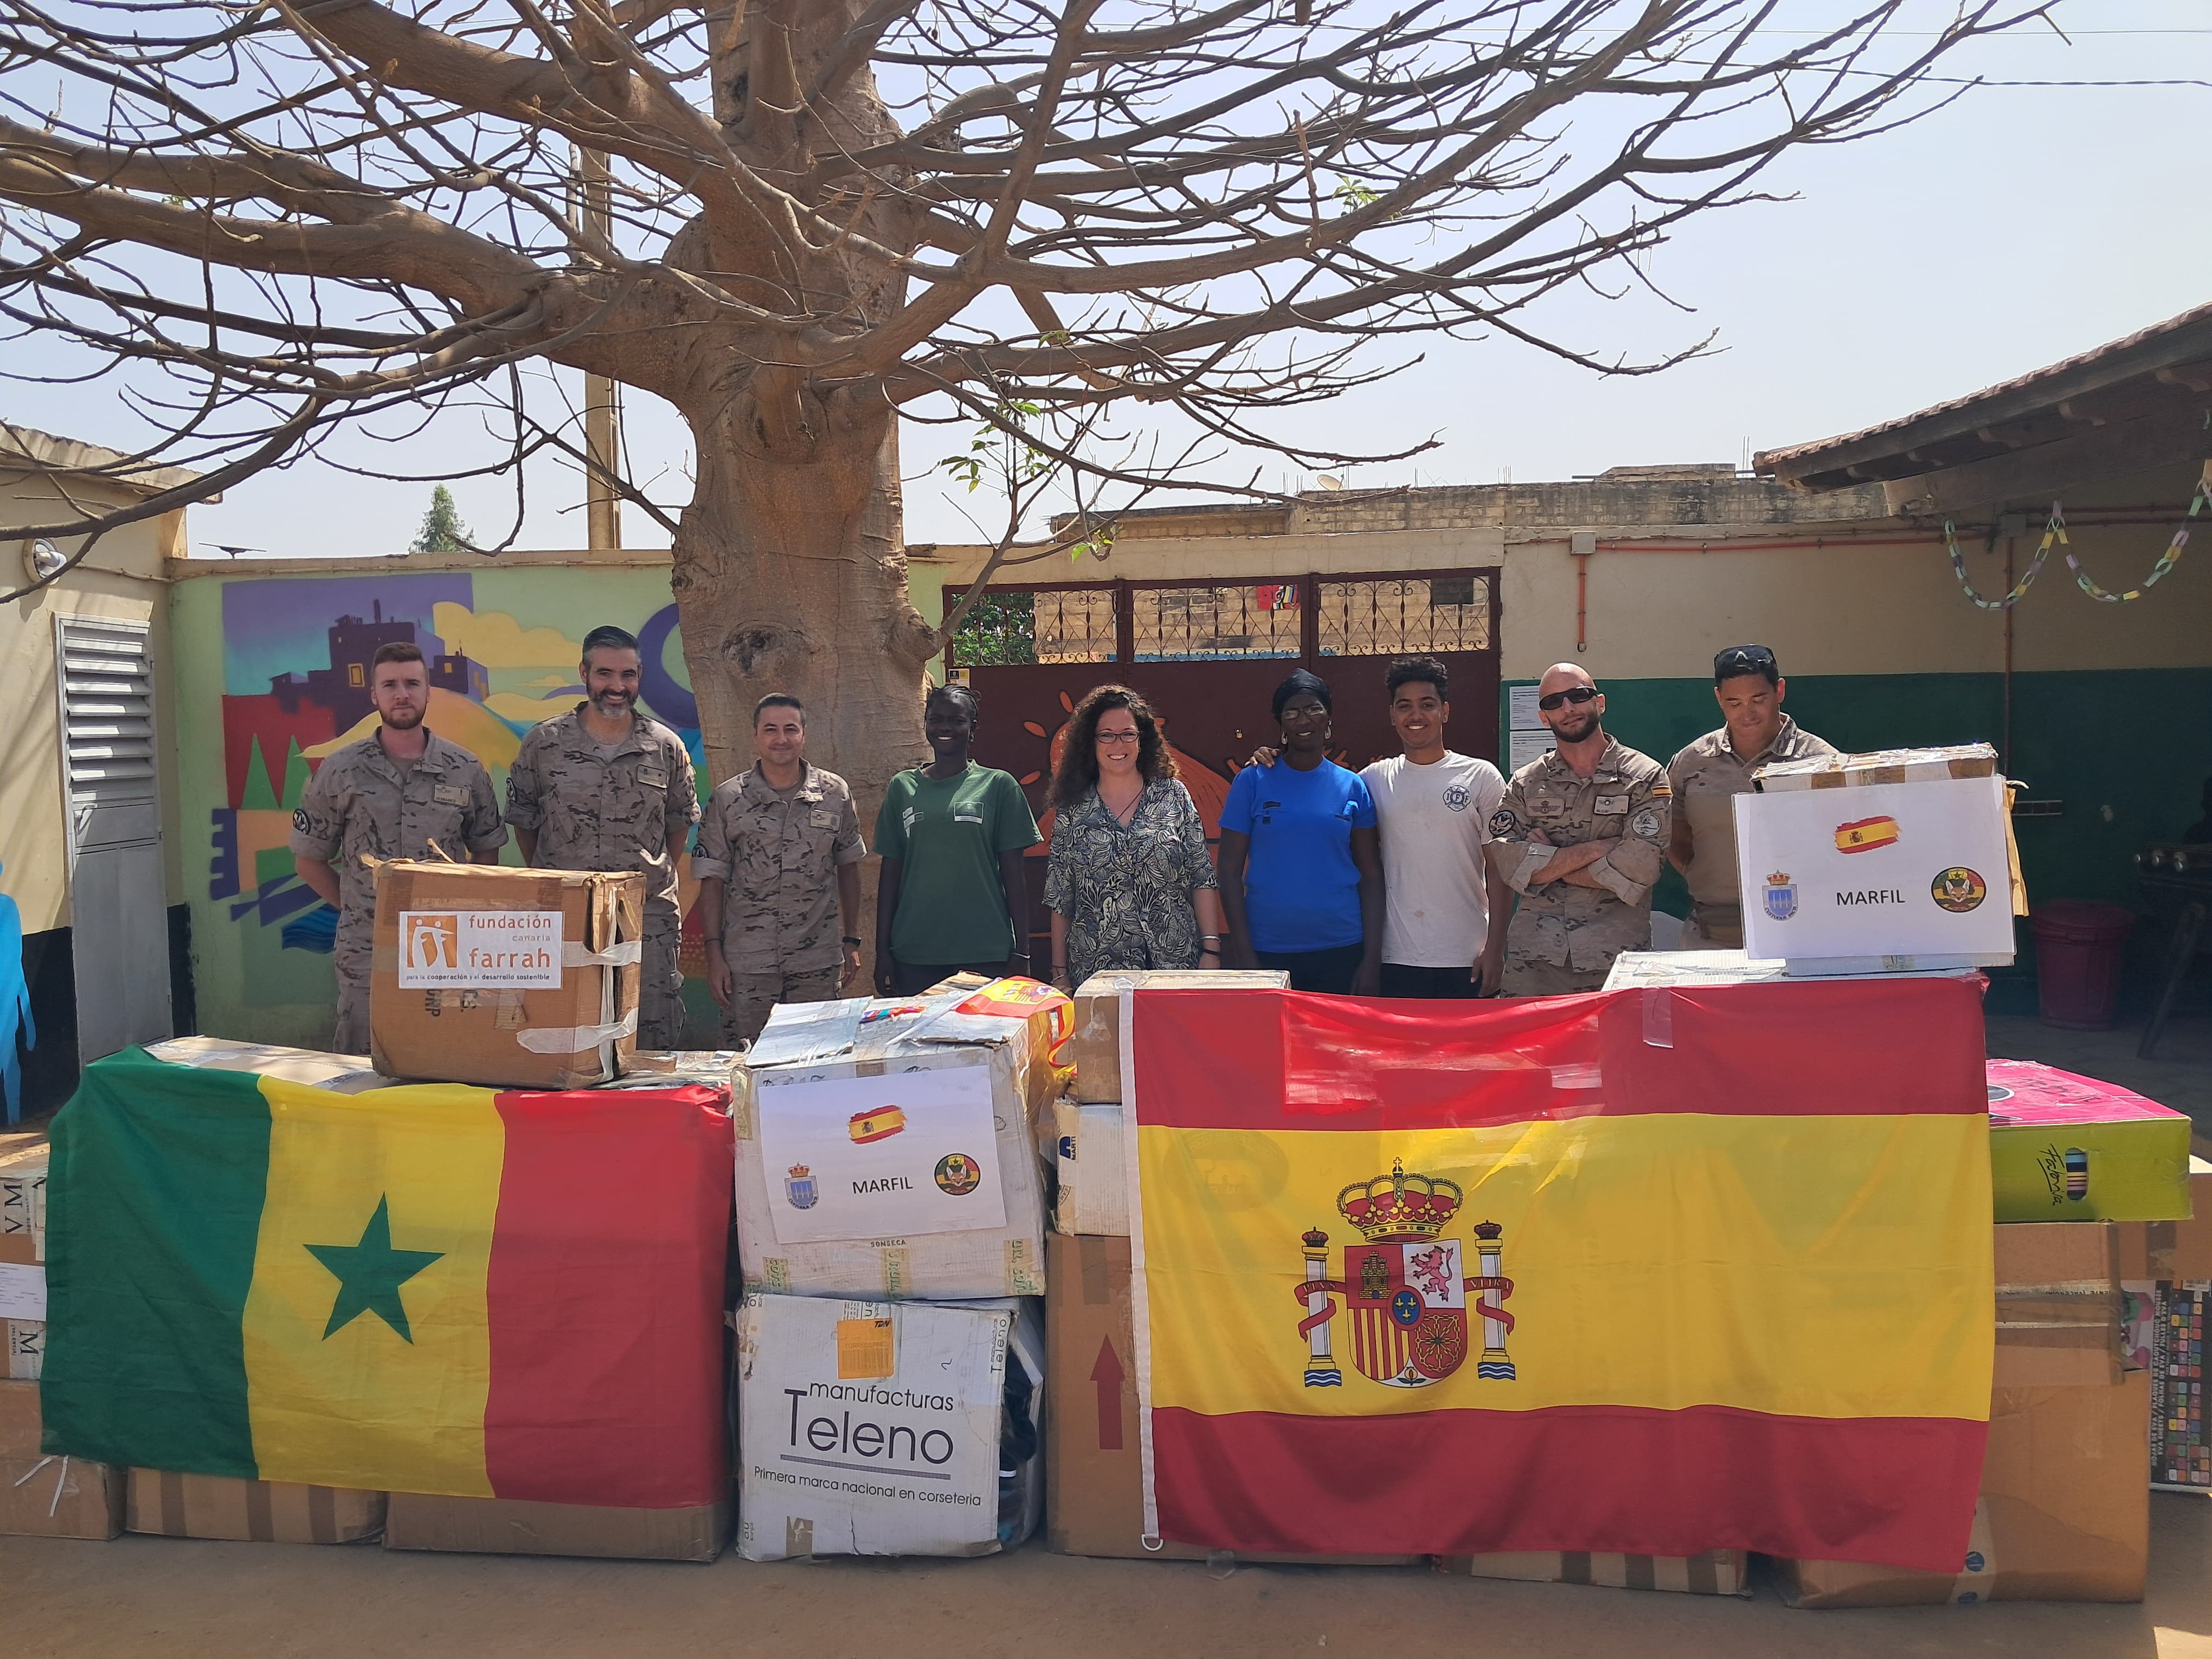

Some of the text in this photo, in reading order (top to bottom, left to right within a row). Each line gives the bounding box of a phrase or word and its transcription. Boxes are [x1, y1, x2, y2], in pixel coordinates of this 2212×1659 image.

[1836, 889, 1906, 906] MARFIL
[469, 914, 552, 929] fundación
[512, 934, 551, 942] canaria
[469, 947, 550, 968] farrah
[3, 1182, 24, 1208] M
[852, 1176, 914, 1194] MARFIL
[870, 1238, 907, 1248] SONSECA
[20, 1330, 39, 1356] M
[990, 1318, 998, 1362] manufacturas
[990, 1319, 1007, 1374] Teleno
[2159, 1369, 2165, 1380] DE
[808, 1381, 954, 1411] manufacturas
[784, 1388, 954, 1465] Teleno
[754, 1465, 982, 1506] Primera marca nacional en corseteria
